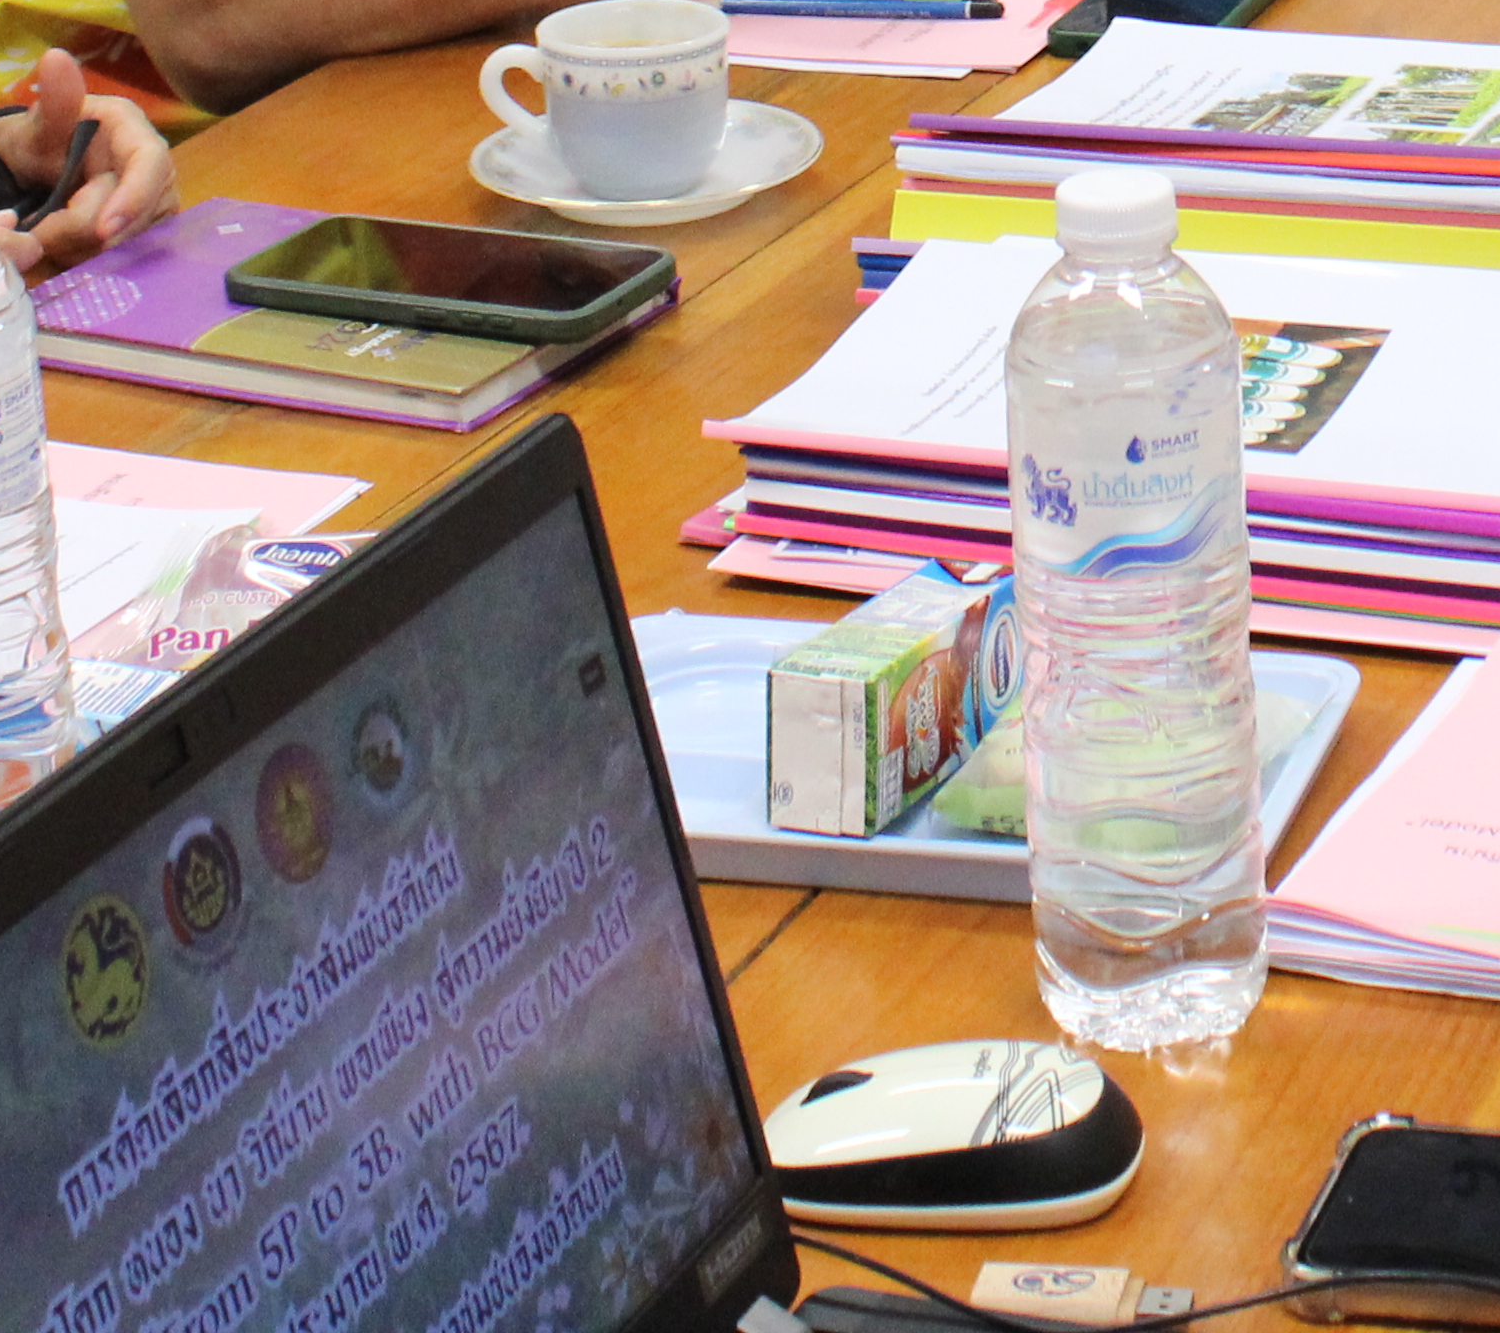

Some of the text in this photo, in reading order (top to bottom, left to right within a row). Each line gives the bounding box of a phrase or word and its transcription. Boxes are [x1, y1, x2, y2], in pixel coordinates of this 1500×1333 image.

[1151, 430, 1199, 450] SMART
[224, 590, 280, 607] CUSTA
[148, 625, 230, 660] Pan
[335, 983, 432, 1100] พอเพียง
[591, 819, 613, 868] 2
[258, 1203, 299, 1283] 5P
[310, 1183, 345, 1226] to
[408, 1049, 475, 1135] with
[476, 985, 542, 1073] BCG
[449, 1101, 522, 1207] 2567
